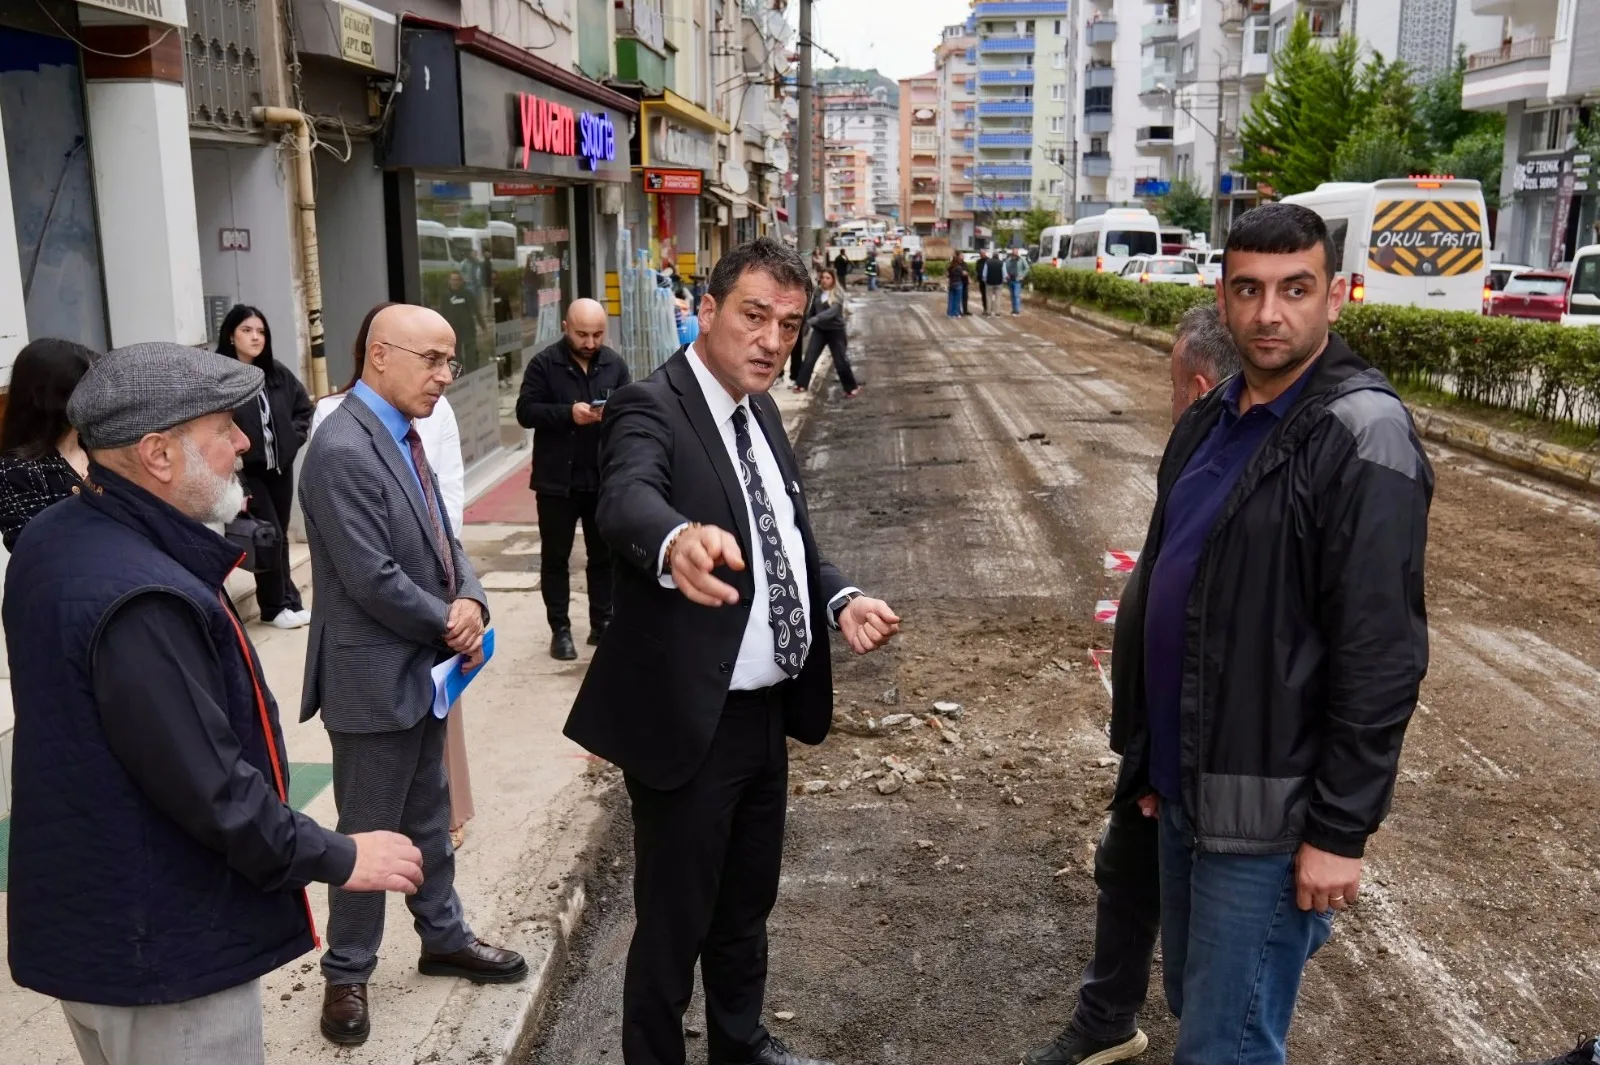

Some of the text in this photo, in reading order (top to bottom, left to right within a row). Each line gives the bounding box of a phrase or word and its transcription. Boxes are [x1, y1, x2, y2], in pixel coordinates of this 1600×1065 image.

[519, 91, 575, 170] yuvam
[580, 111, 615, 171] sigorta
[1377, 231, 1480, 248] OKUL TAŞITI
